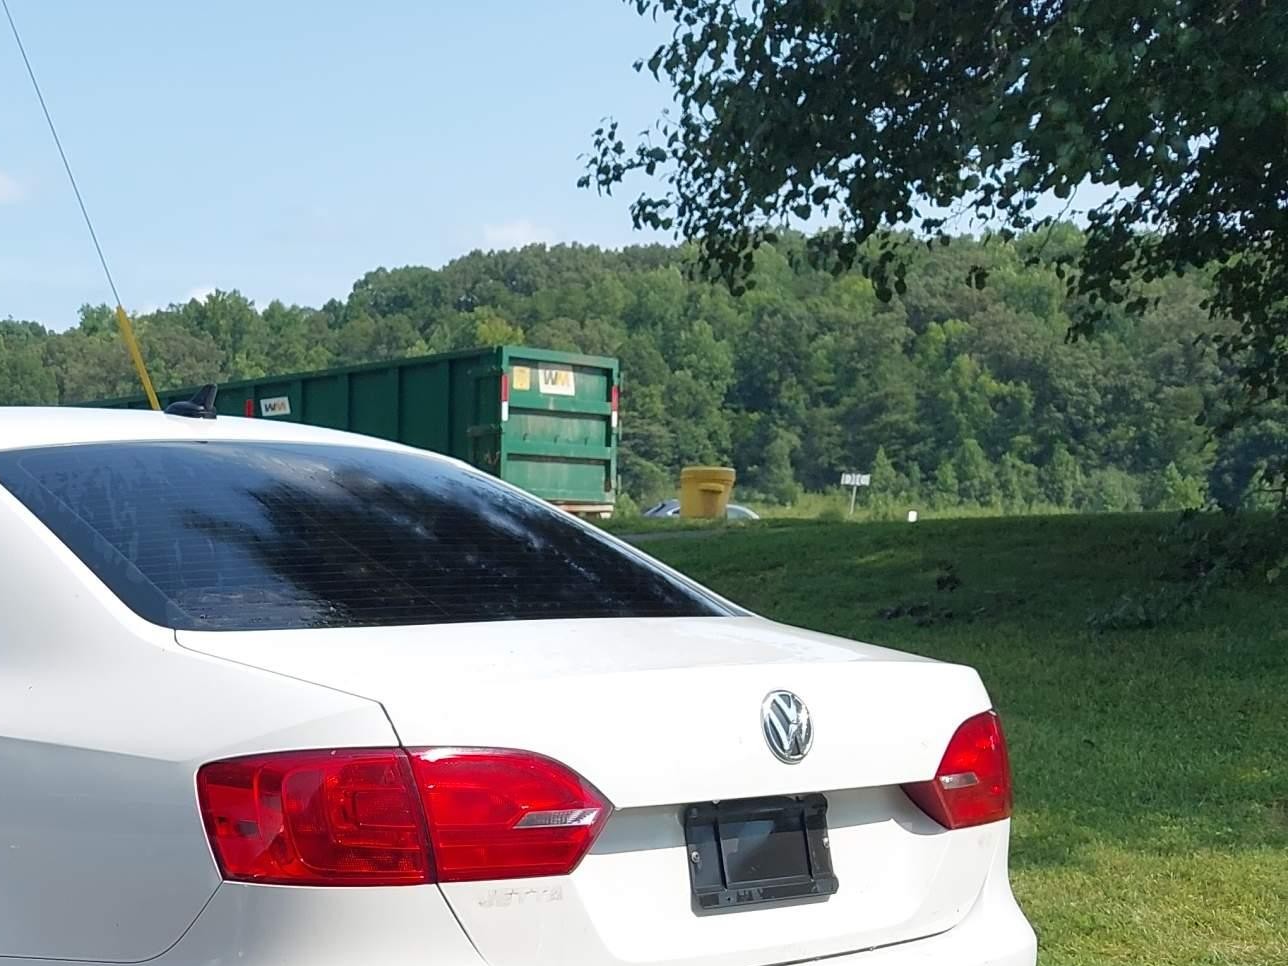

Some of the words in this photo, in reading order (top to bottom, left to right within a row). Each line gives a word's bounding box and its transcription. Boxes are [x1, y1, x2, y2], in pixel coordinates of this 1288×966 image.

[544, 368, 570, 386] WM
[264, 401, 288, 412] WM
[761, 691, 813, 763] VW
